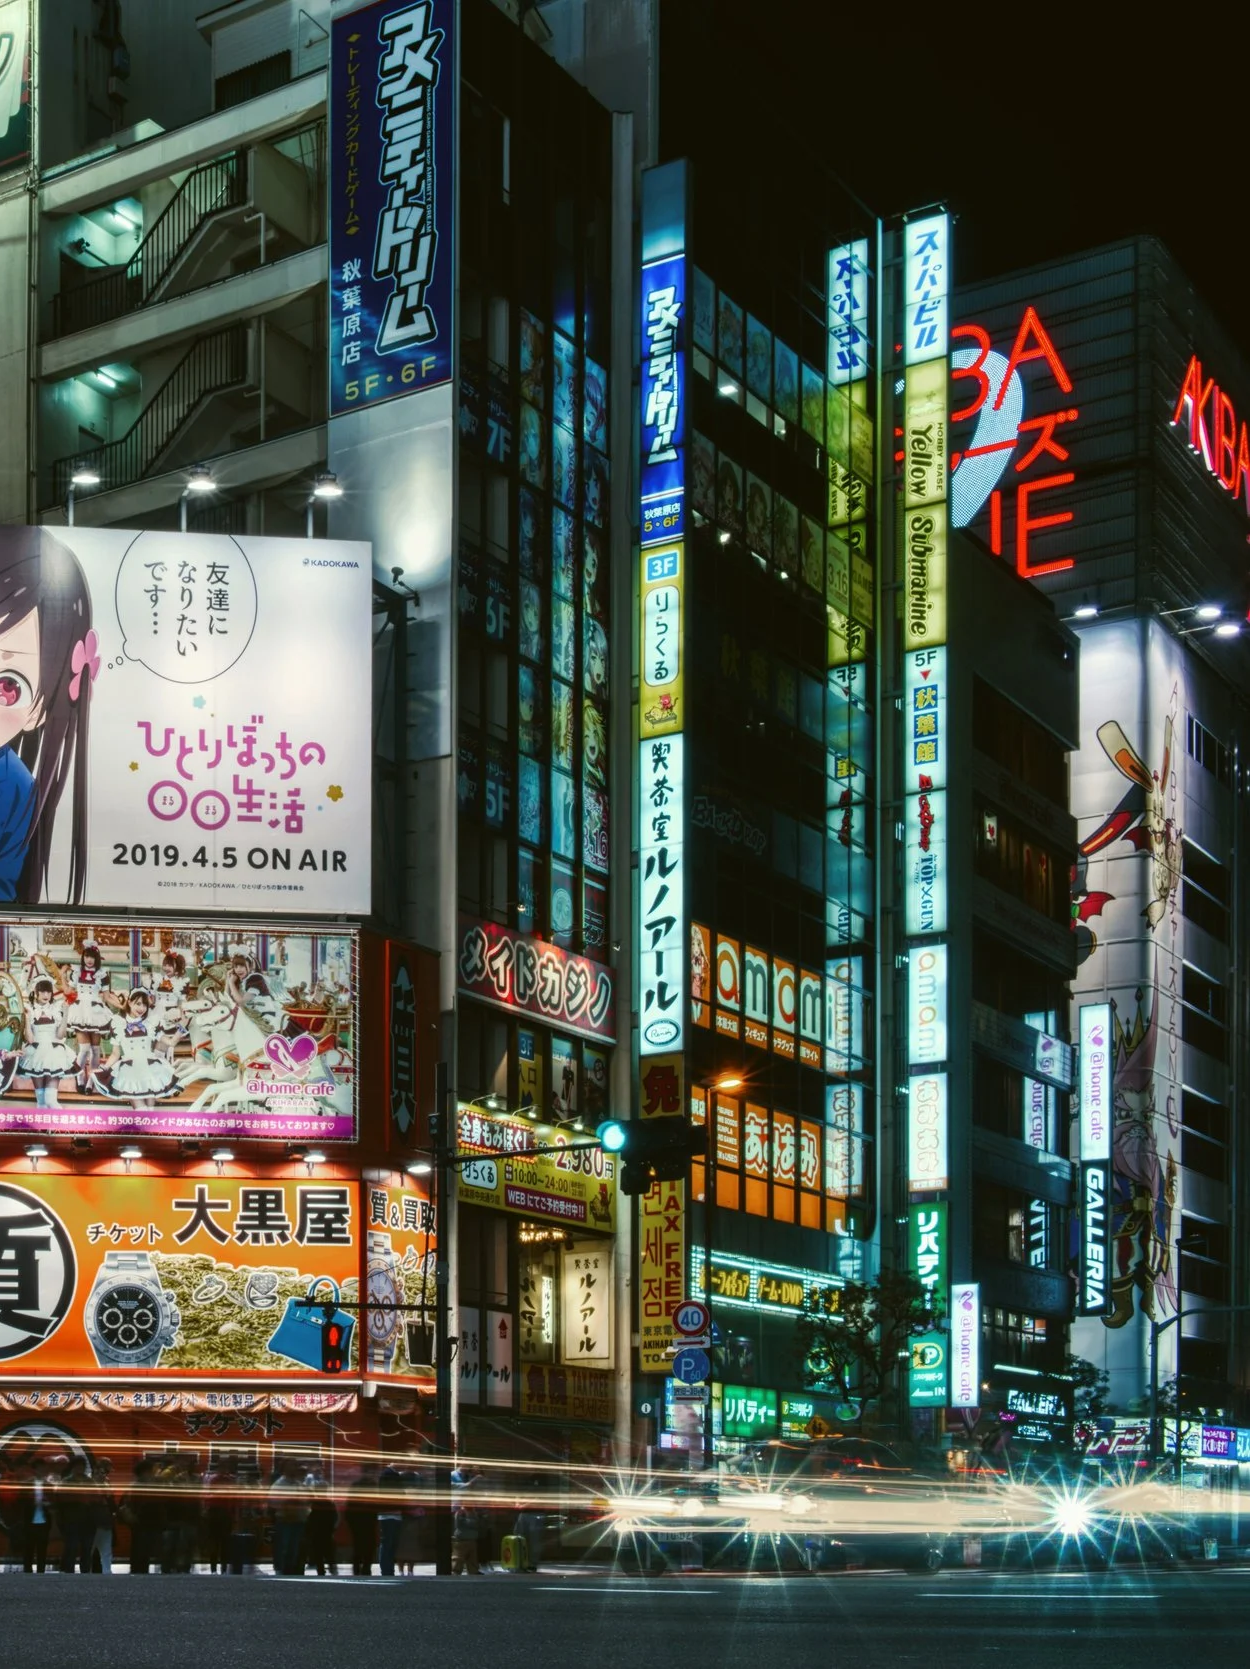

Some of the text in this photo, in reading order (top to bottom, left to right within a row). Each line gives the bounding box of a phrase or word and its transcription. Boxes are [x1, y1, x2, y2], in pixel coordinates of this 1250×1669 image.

[341, 257, 363, 367] 秋葉原店
[912, 228, 945, 349] スーパービル
[485, 416, 512, 463] 7F
[908, 424, 935, 500] Yellow
[937, 421, 945, 458] HOBBY
[310, 558, 360, 569] KADOKAWA
[650, 557, 675, 579] 3F
[908, 514, 935, 638] Submarine
[176, 560, 199, 657] なりたい
[206, 561, 231, 636] 友達に
[485, 598, 512, 643] 6F
[654, 591, 670, 682] りらくる
[915, 651, 938, 668] 5F
[136, 714, 327, 781] ひとりぼっちの
[915, 685, 938, 765] 秋葉館
[485, 779, 512, 823] 5F
[111, 842, 348, 873] 2019.4.5 ON AIR
[460, 929, 612, 1028] メイドカジノ
[917, 952, 938, 1060] amiami
[304, 1082, 336, 1097] cafe
[1089, 1051, 1106, 1142] @home cafe
[914, 1079, 940, 1173] あみあみ
[171, 1183, 353, 1248] 大黒屋
[507, 1188, 526, 1205] WEB
[87, 1222, 164, 1244] チケット
[1085, 1166, 1105, 1310] GALLERIA
[578, 1272, 598, 1353] ルノアール
[680, 1309, 702, 1328] 40
[681, 1358, 694, 1381] P
[934, 1386, 947, 1397] IN
[960, 1371, 972, 1402] cafe
[184, 1413, 285, 1436] チケット
[725, 1398, 777, 1424] リバティー
